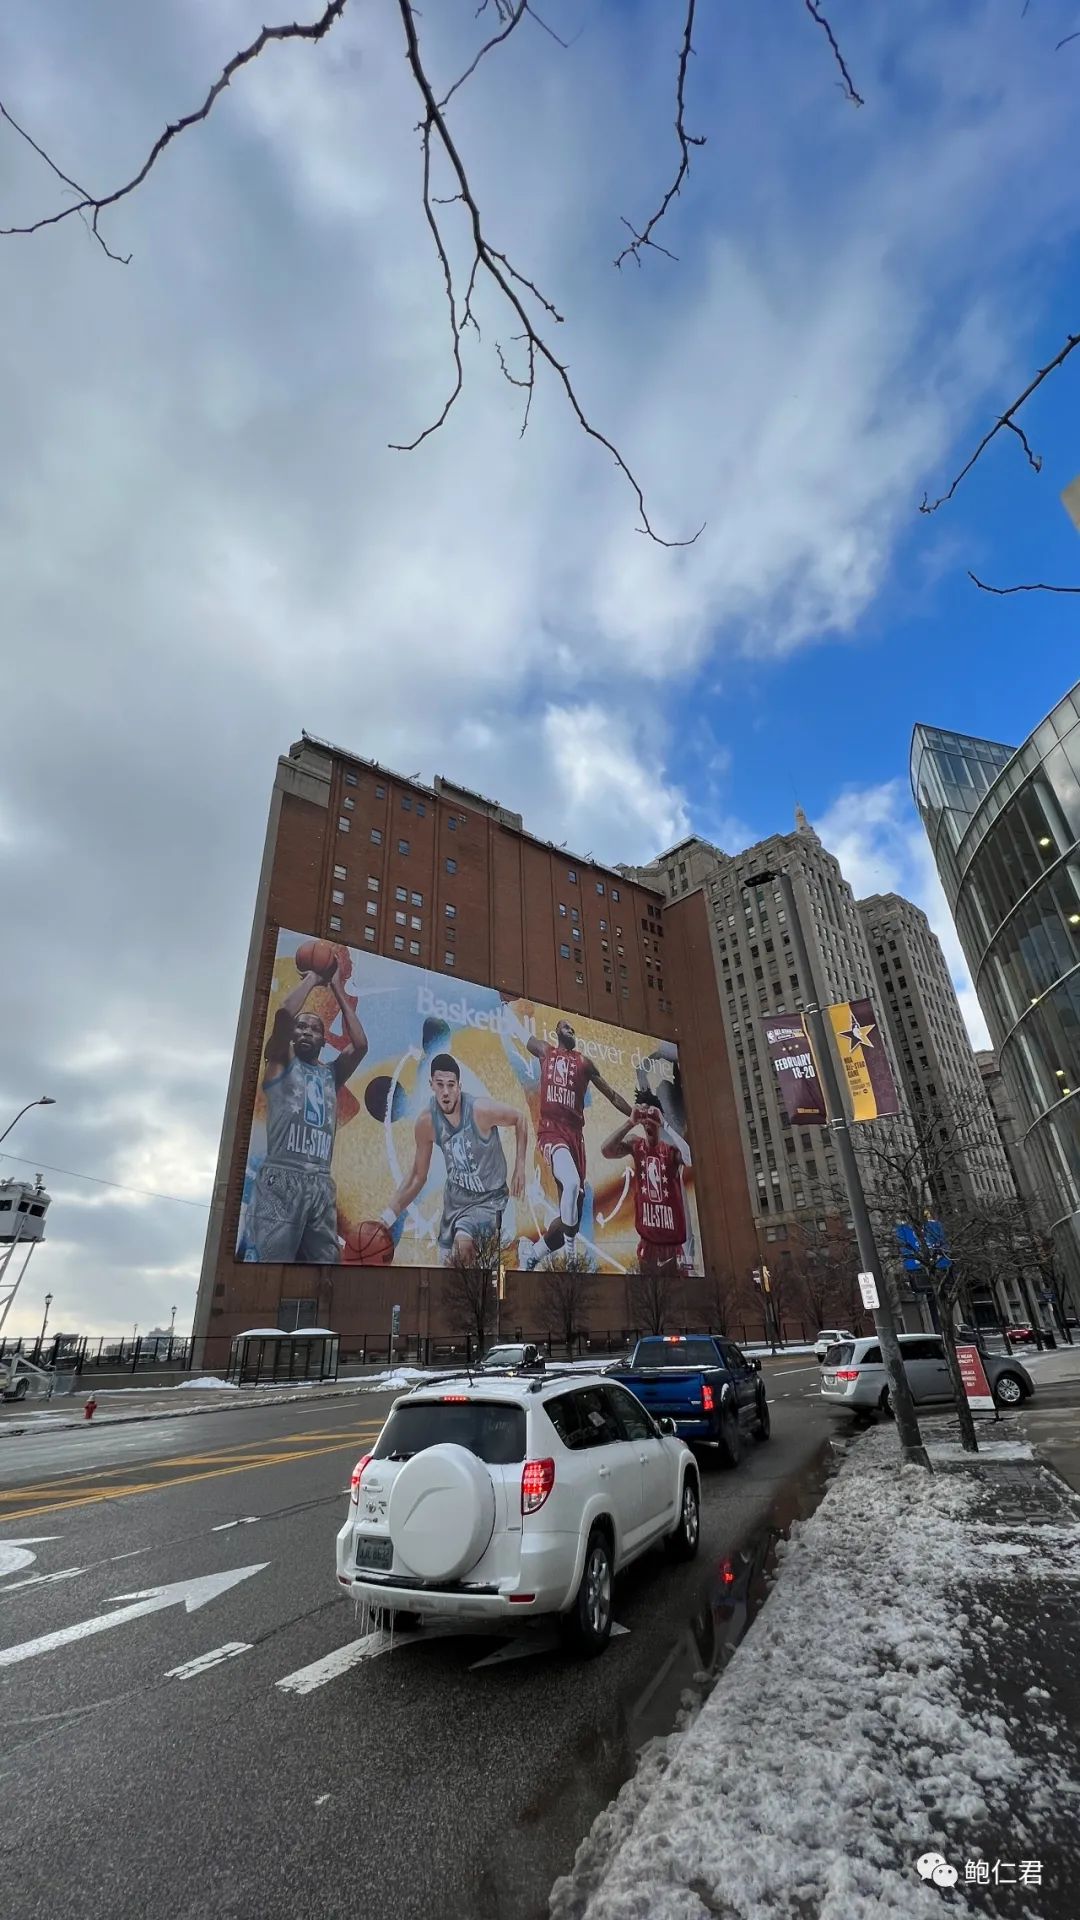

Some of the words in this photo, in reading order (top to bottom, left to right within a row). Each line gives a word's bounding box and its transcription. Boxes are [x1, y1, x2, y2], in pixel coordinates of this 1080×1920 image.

[417, 985, 536, 1040] Basketll
[576, 1038, 624, 1065] never
[774, 1053, 811, 1072] FEBRUARY
[792, 1066, 815, 1079] 18-20
[546, 1085, 576, 1109] ALL-STAR
[287, 1122, 332, 1160] ALL-STAR
[642, 1202, 675, 1231] ALL-STAR
